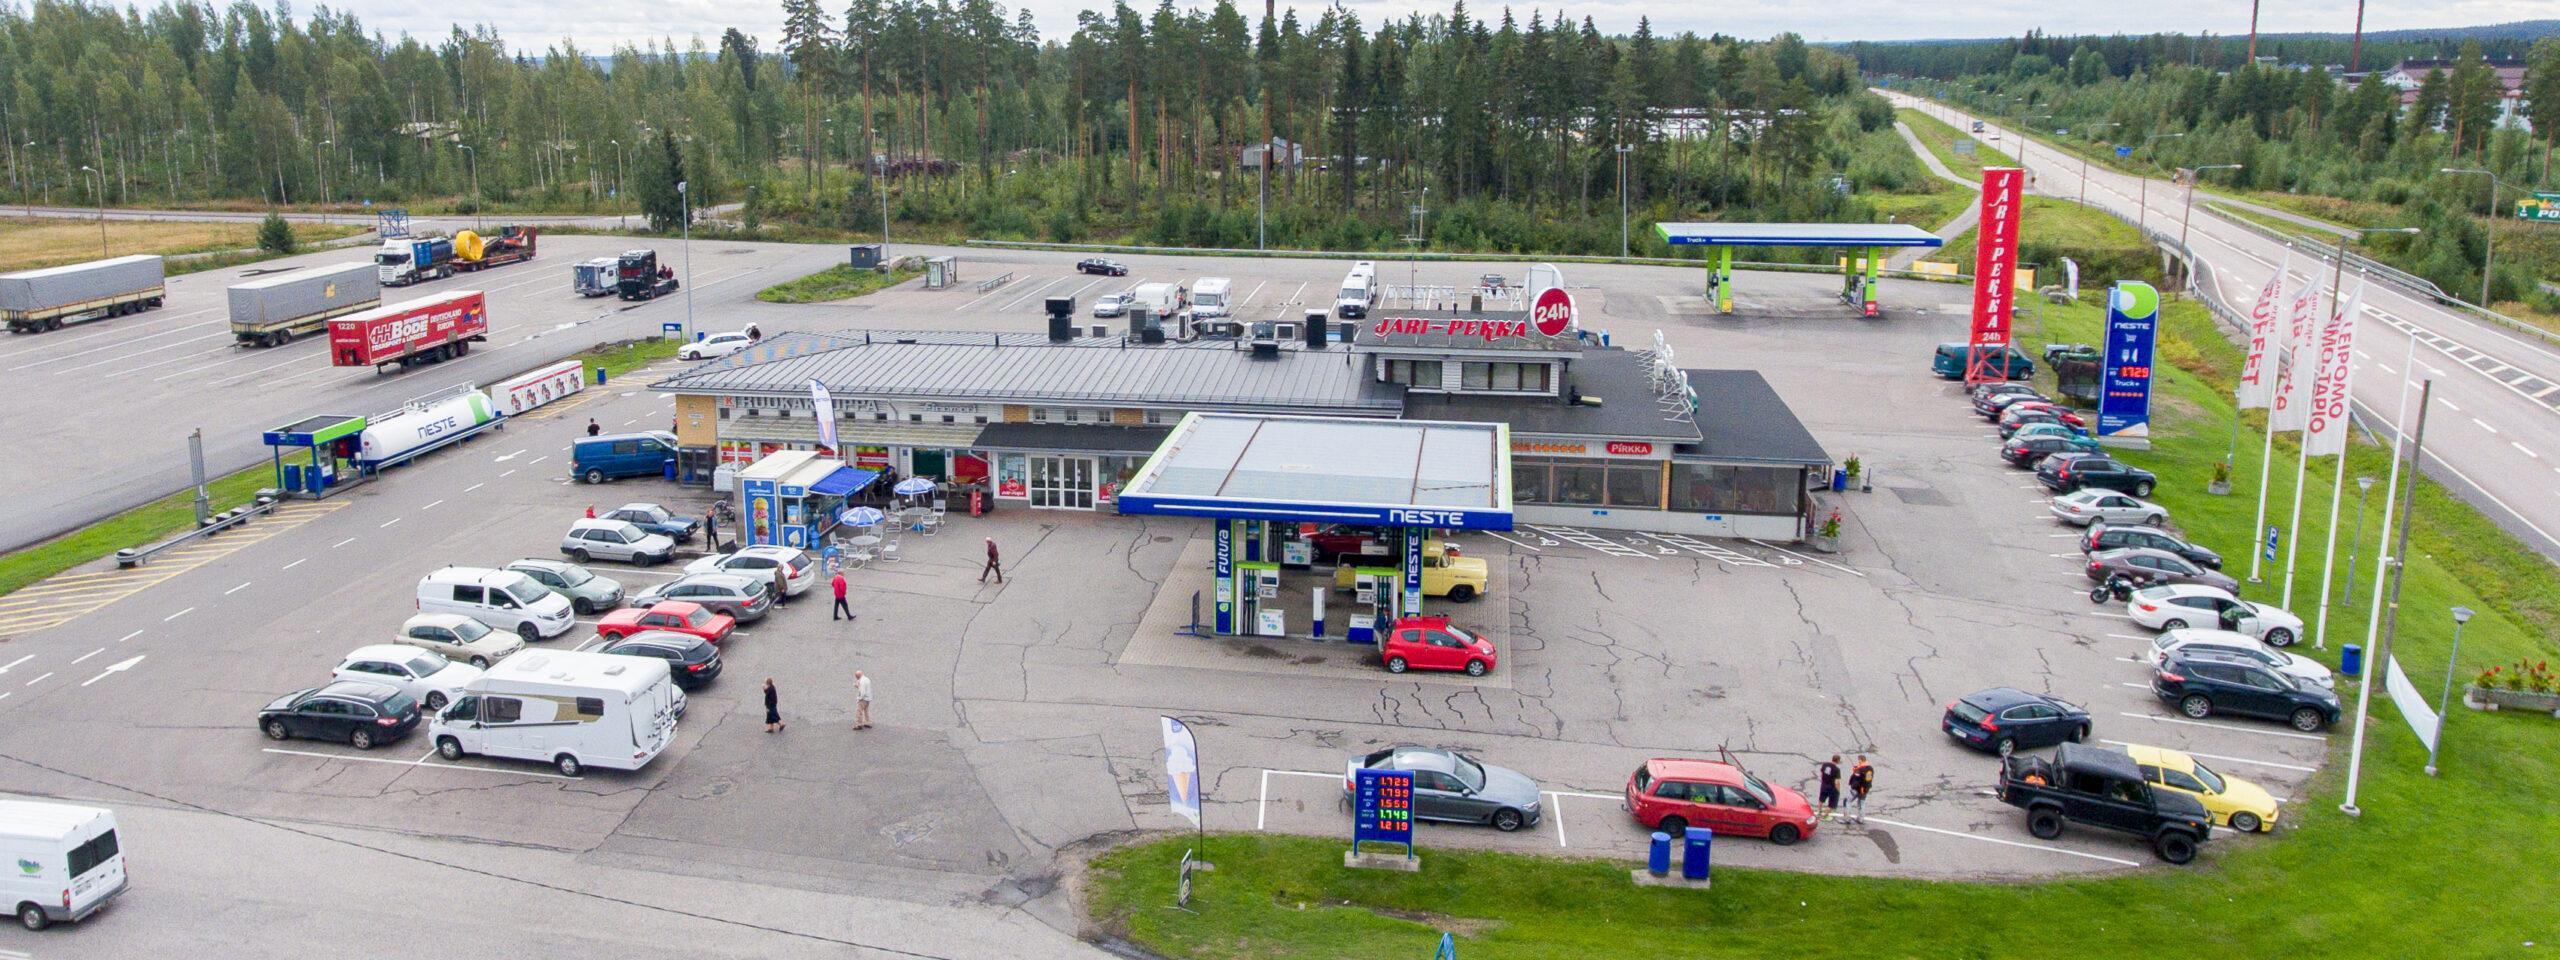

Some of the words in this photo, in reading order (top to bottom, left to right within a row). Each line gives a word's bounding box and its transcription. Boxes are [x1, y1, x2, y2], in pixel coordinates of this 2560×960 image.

[1987, 173, 2011, 328] JARI-PEKKA
[1536, 303, 1569, 323] 24h
[1375, 318, 1526, 342] JARI-PEKKA
[2114, 322, 2151, 330] NESTE
[1982, 332, 2001, 342] 24h
[372, 339, 402, 351] TRANSPORT
[743, 397, 878, 412] RUOKAKUPPA
[417, 416, 457, 440] NESTE
[1390, 509, 1464, 526] NESTE
[1408, 536, 1418, 584] NESTE
[1381, 777, 1409, 787] 1.729
[1380, 809, 1408, 820] 1.749
[1380, 820, 1408, 831] 1.219
